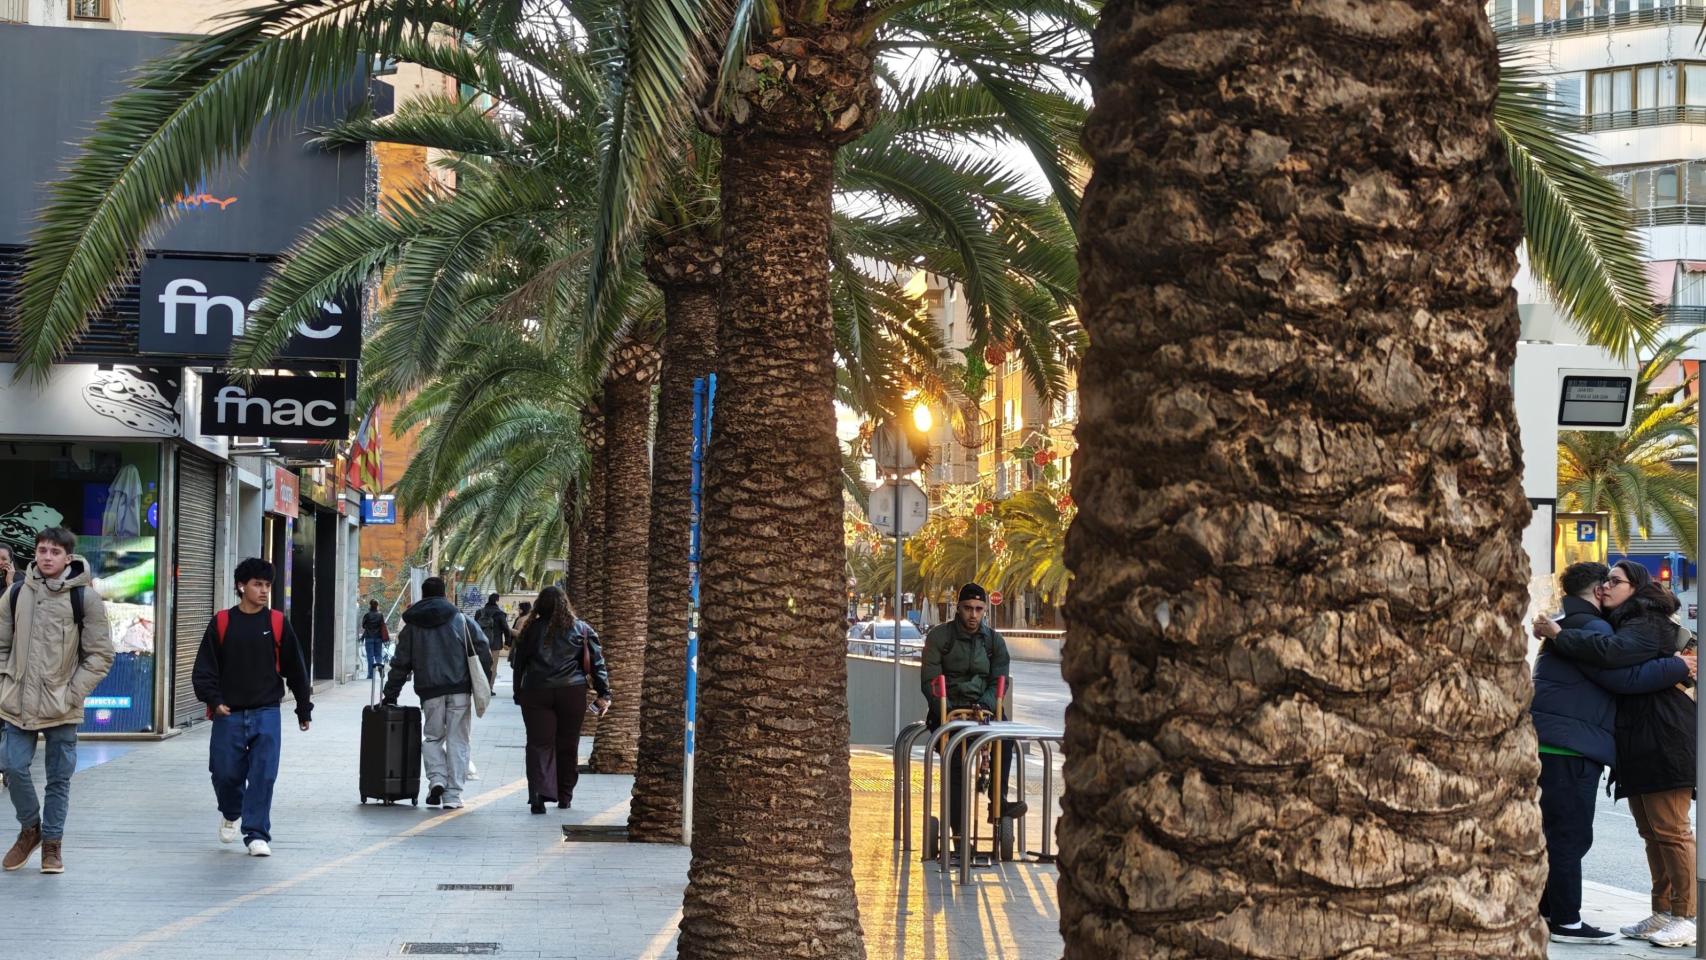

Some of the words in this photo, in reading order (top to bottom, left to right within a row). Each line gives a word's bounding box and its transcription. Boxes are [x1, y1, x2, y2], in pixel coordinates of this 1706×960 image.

[158, 278, 342, 339] fnc
[213, 386, 337, 427] fnac
[1580, 523, 1593, 540] P
